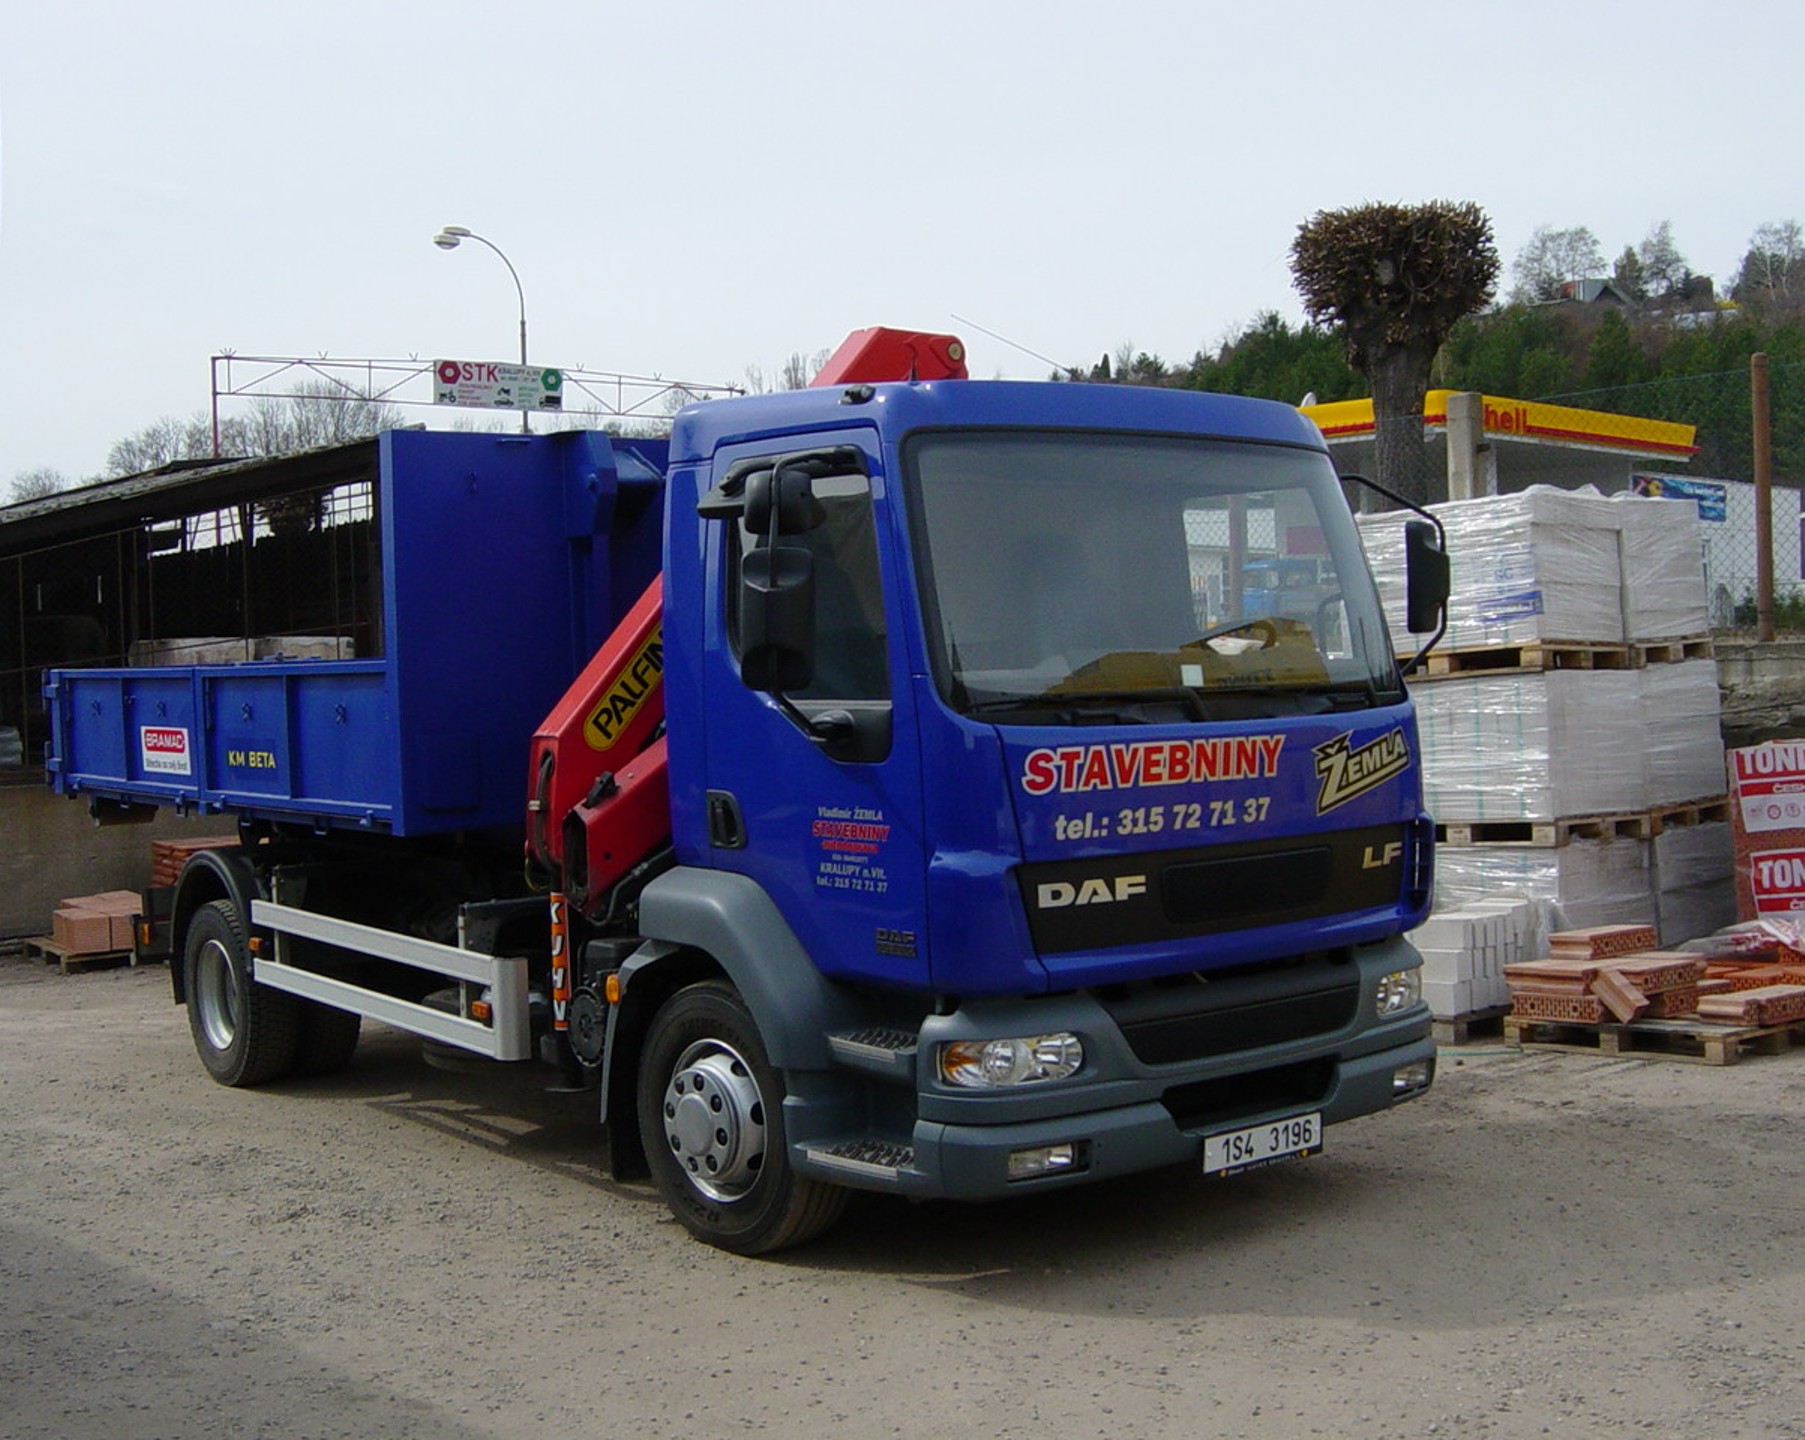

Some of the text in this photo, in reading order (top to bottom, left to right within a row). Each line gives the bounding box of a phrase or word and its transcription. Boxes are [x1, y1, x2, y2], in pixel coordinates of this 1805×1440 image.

[461, 362, 499, 382] STK
[146, 732, 184, 749] BRAMAC
[228, 750, 276, 769] KM BETA
[1022, 734, 1286, 795] STAVEBNINY
[813, 820, 890, 841] STAVEBNINY
[1055, 797, 1270, 841] tel.: 315 72 71 37
[1363, 841, 1402, 869] LF
[820, 862, 861, 876] KRALUPY
[1037, 875, 1147, 909] DAF
[1222, 1119, 1312, 1163] 1S4 3196
